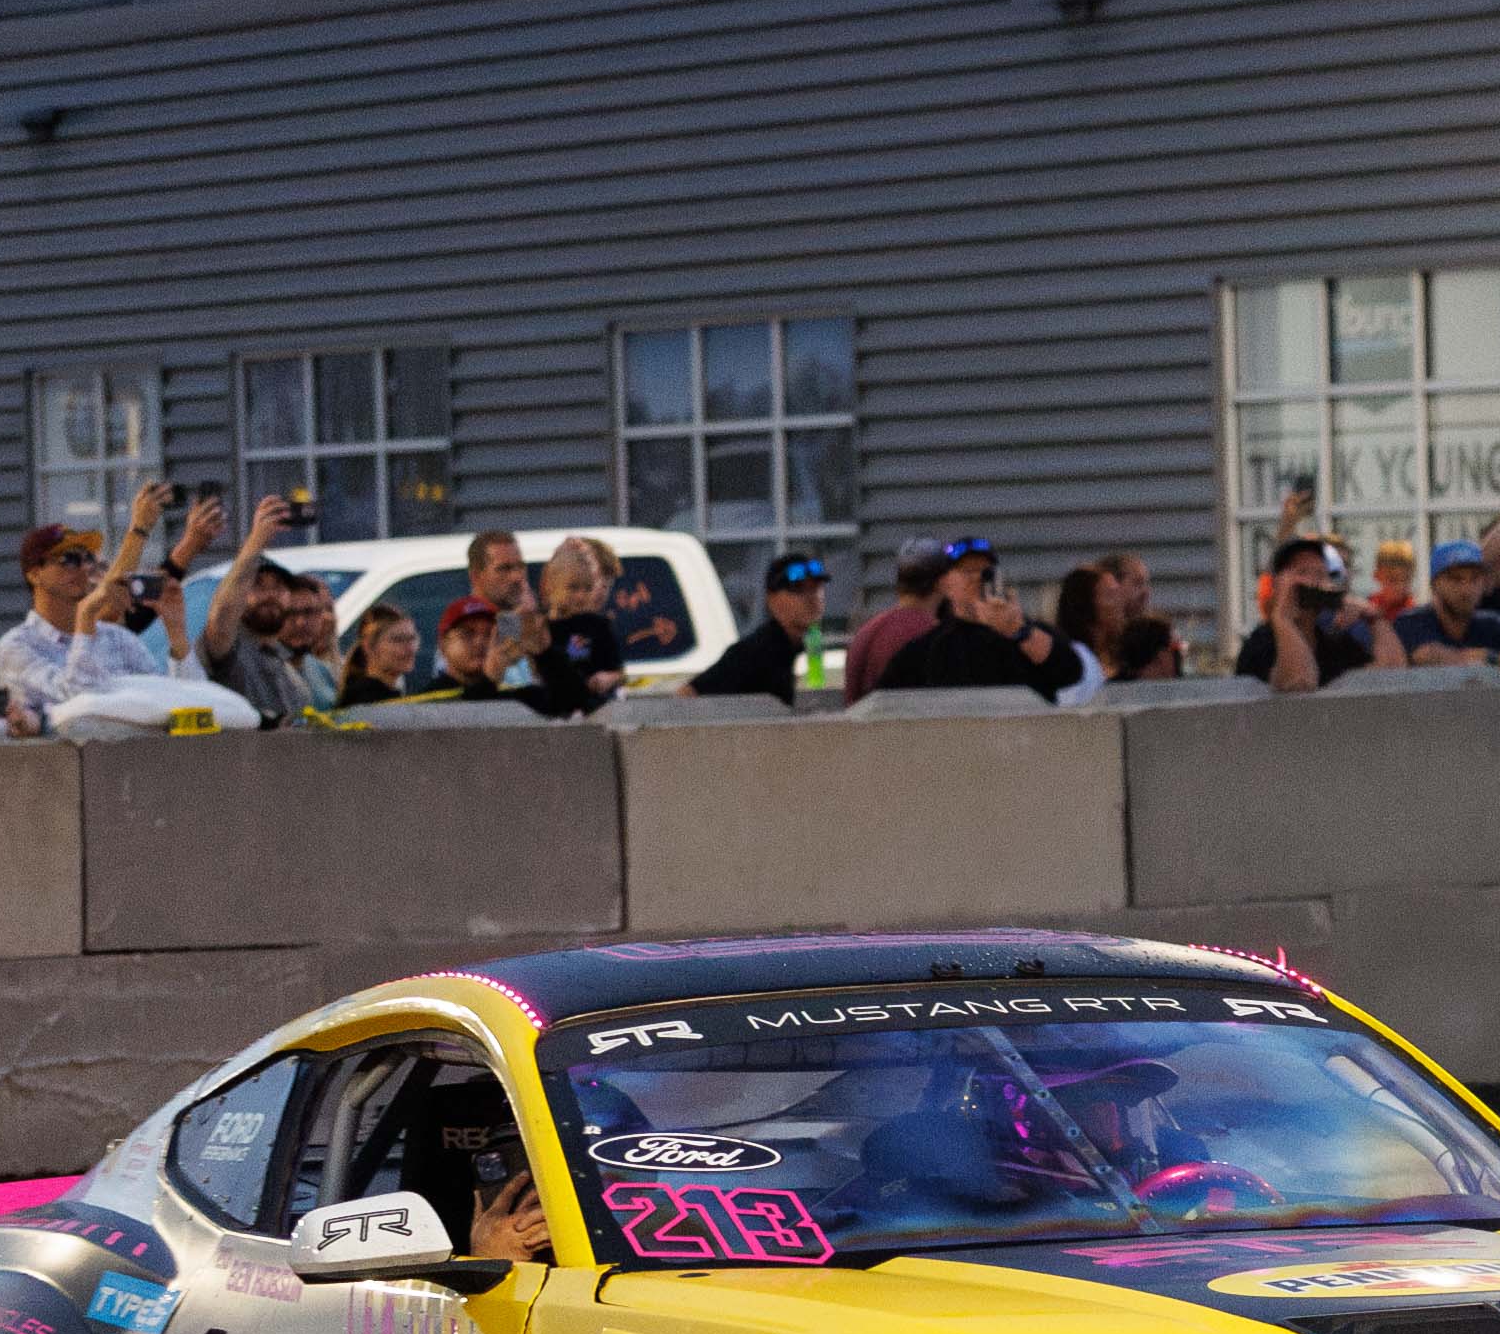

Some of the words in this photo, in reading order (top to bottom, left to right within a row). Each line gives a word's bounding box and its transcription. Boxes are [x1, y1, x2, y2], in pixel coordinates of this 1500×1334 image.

[746, 997, 1054, 1030] MUSTANG
[1062, 996, 1188, 1013] RTR
[624, 1135, 745, 1167] Ford
[601, 1181, 836, 1265] 213
